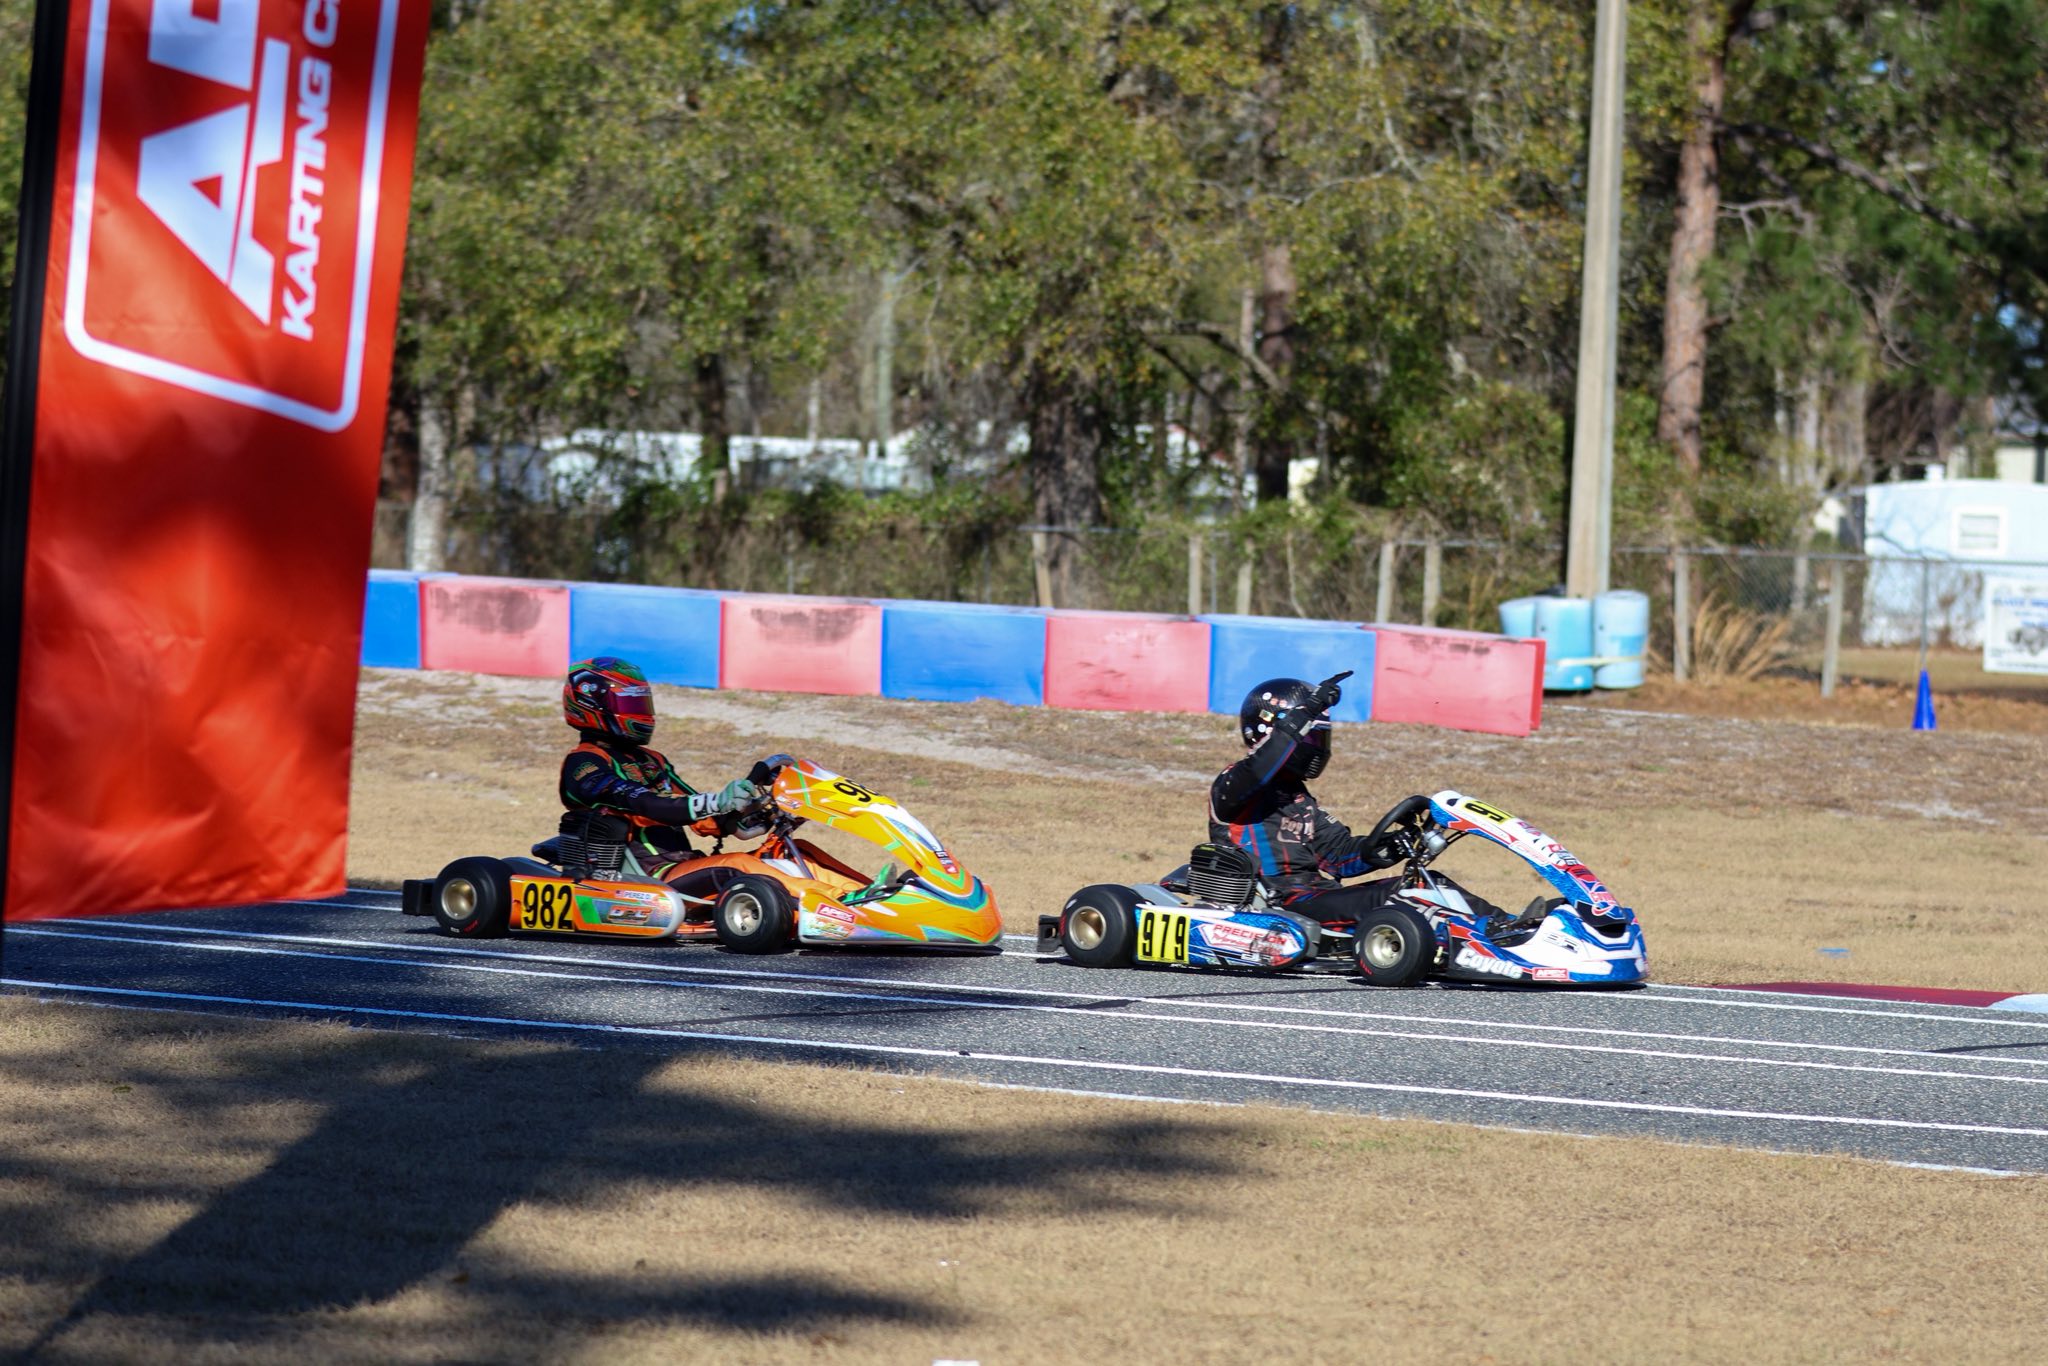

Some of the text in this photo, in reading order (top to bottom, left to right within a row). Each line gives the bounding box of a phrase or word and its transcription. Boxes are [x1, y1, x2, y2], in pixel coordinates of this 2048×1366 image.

[282, 0, 340, 341] KARTING C
[523, 883, 573, 929] 982
[624, 891, 644, 900] PEREZ
[1142, 912, 1187, 961] 979
[1455, 947, 1524, 979] Coyote
